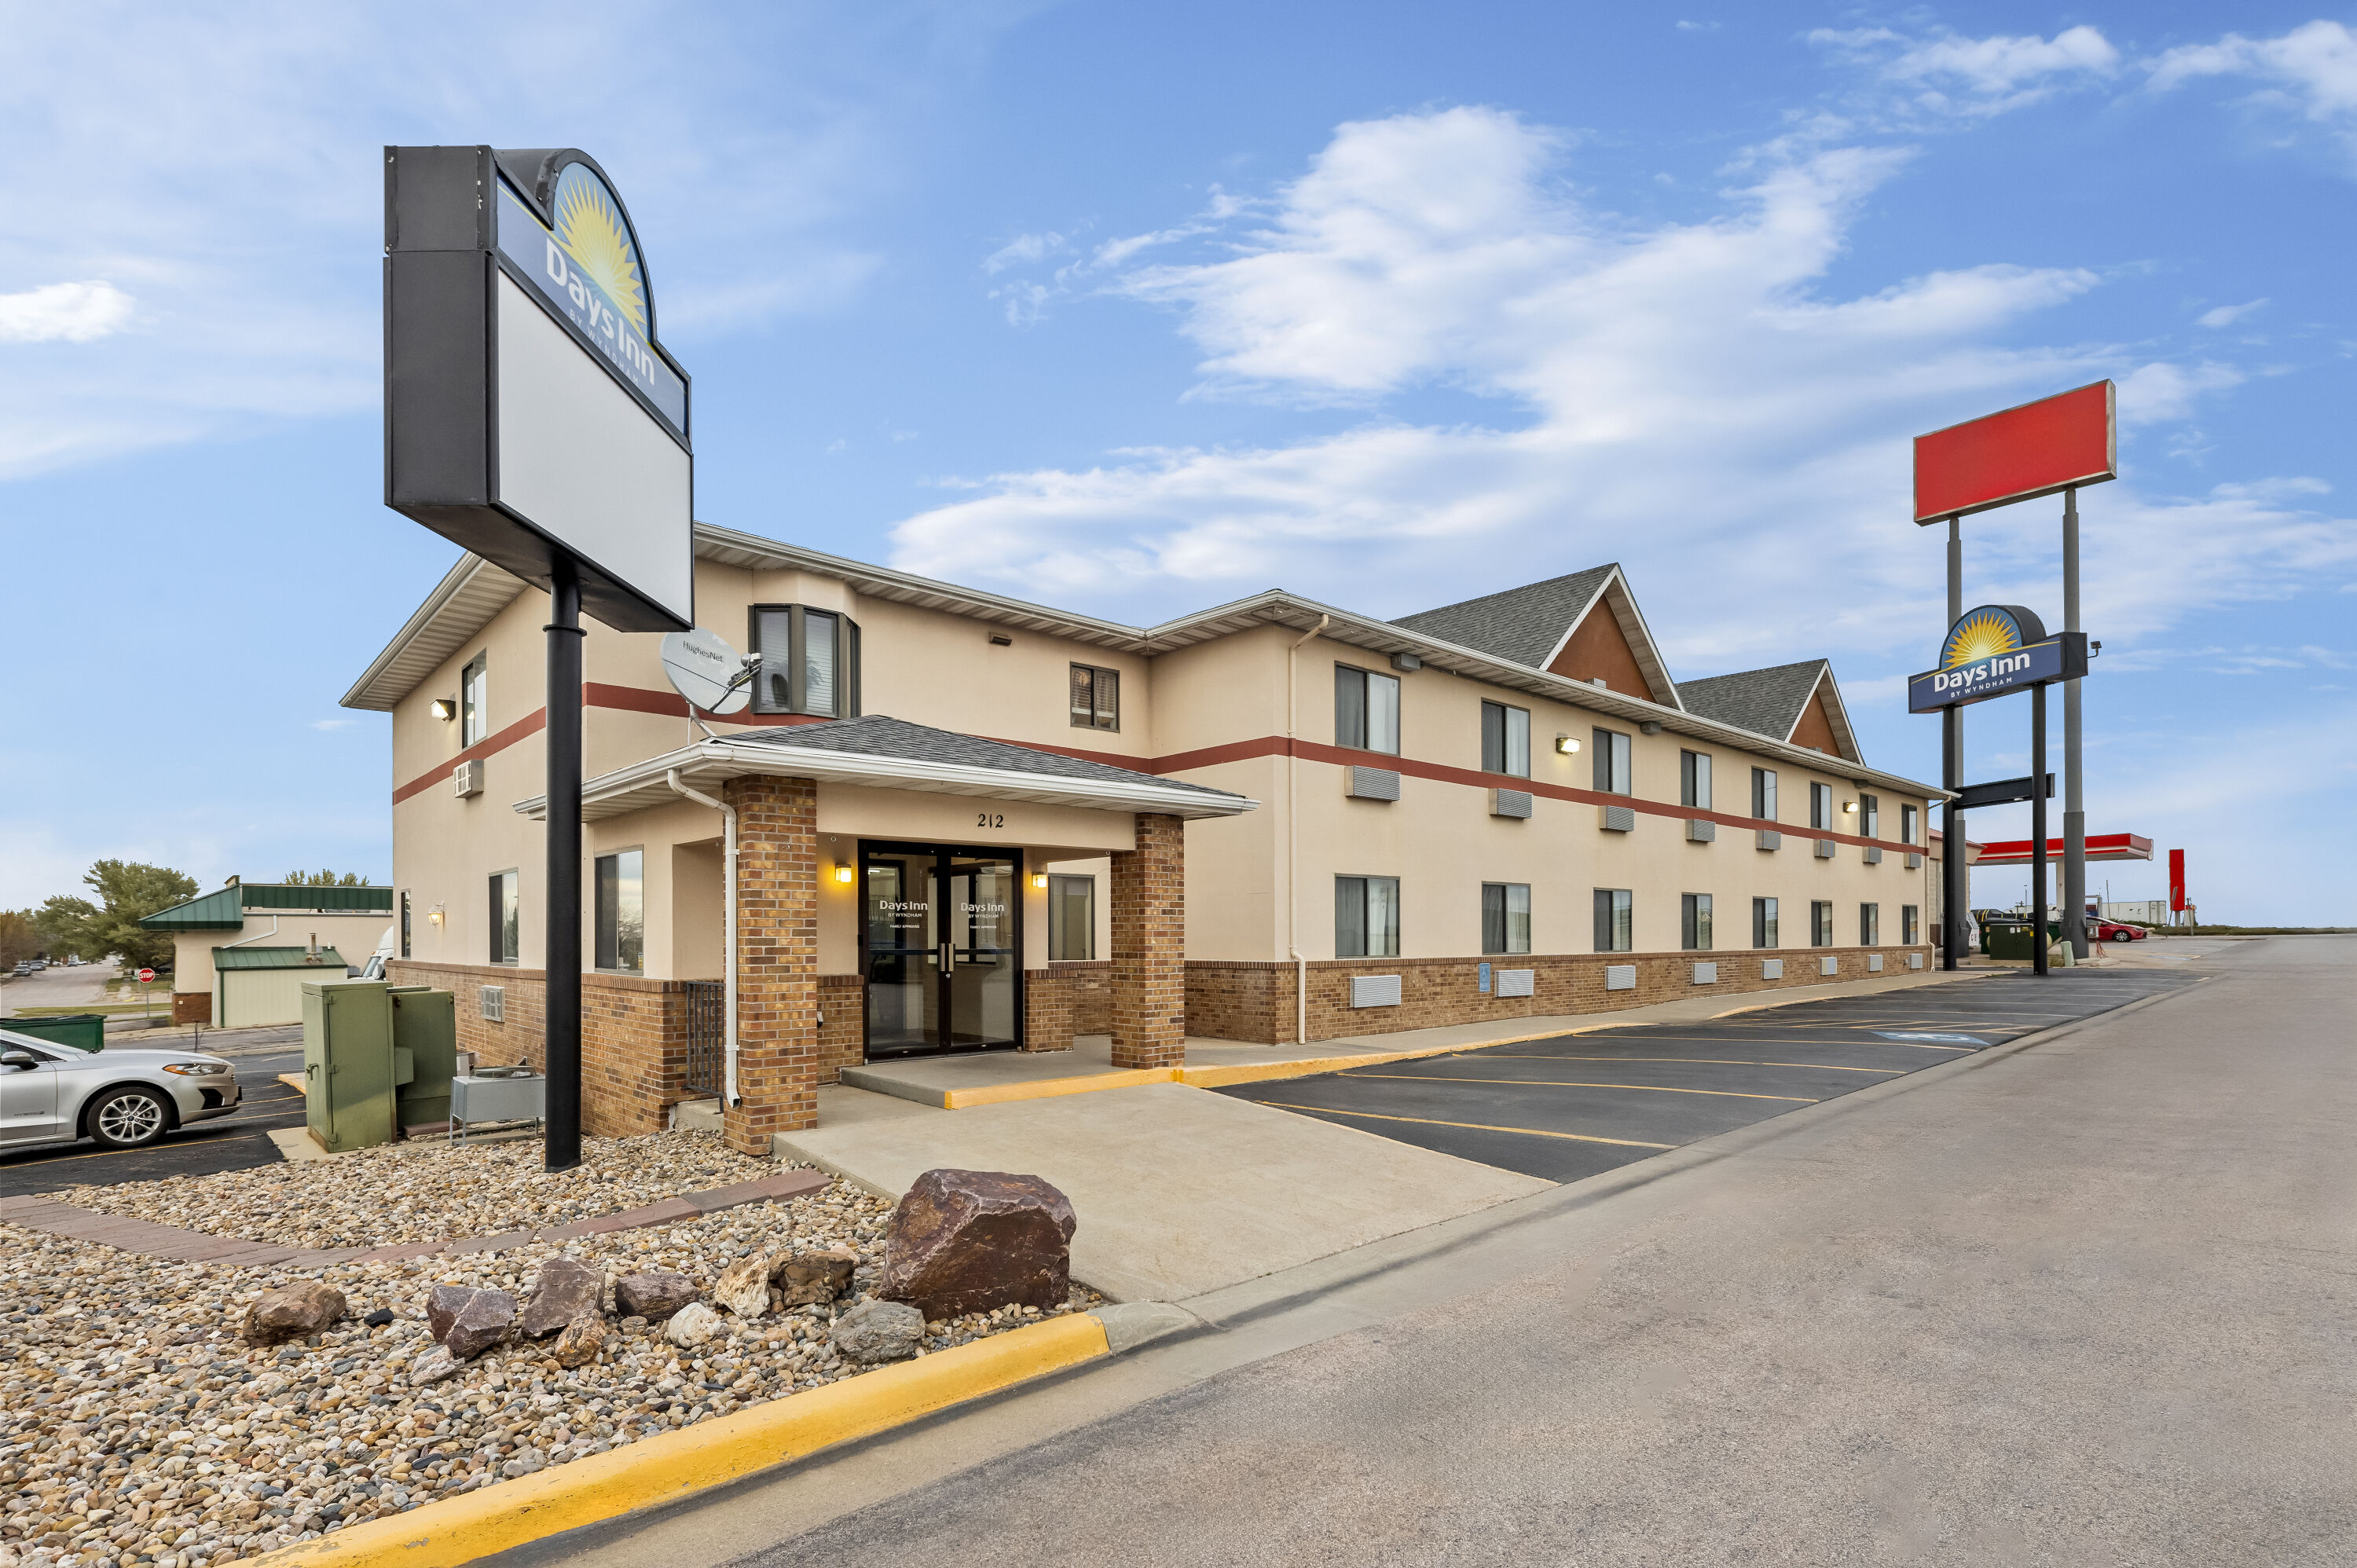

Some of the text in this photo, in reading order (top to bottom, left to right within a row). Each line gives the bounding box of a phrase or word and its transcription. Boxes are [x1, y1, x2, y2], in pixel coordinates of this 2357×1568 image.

[547, 237, 654, 386] Days Inn
[569, 308, 639, 386] BY WYNDHAM
[683, 640, 723, 662] HughesNet
[1934, 653, 2030, 693] Days Inn
[1964, 677, 2012, 694] WYNDHAM
[977, 813, 1004, 829] 212
[880, 900, 928, 911] Days Inn
[961, 902, 1004, 913] Days Inn
